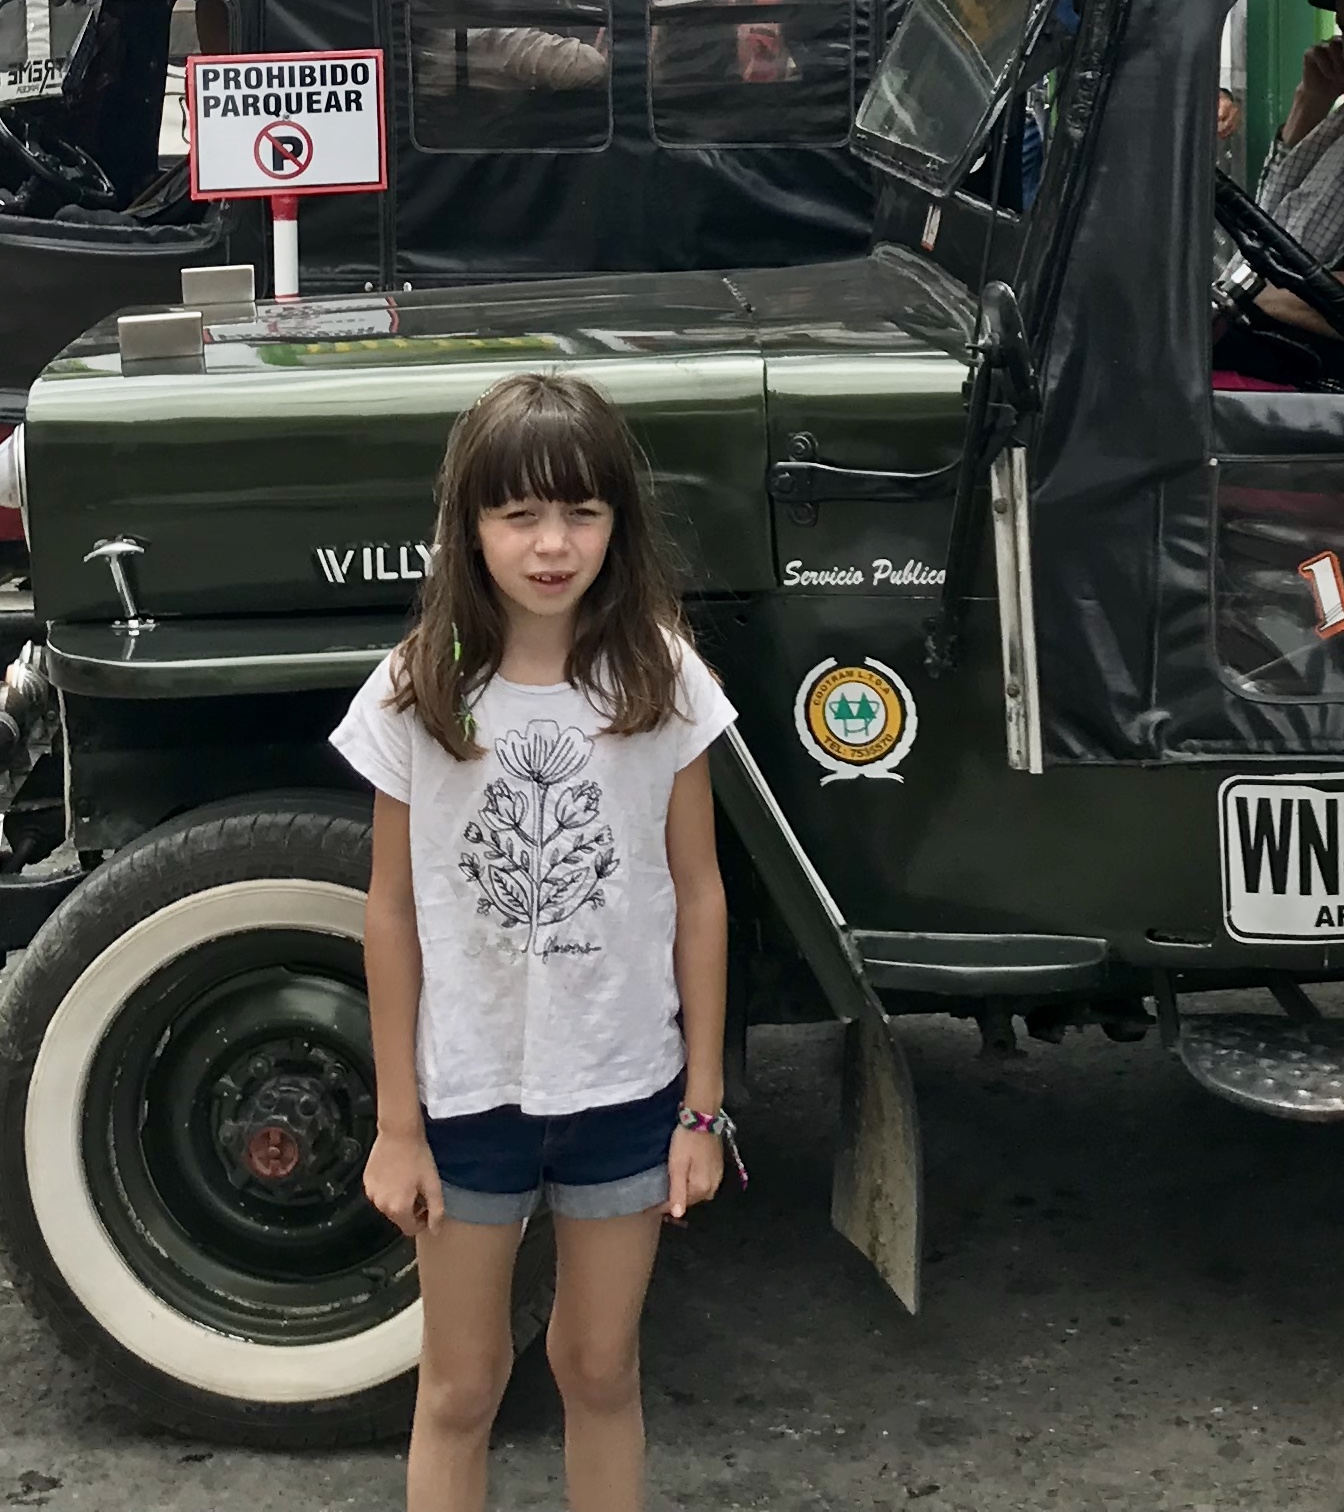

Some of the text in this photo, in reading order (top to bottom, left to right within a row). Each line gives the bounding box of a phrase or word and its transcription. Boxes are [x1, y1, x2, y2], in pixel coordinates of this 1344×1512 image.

[202, 63, 370, 91] PROHIBIDO
[203, 90, 363, 118] PARQUEAR
[272, 136, 303, 171] P
[316, 544, 441, 583] WILLY
[783, 559, 946, 586] Servicio Publico
